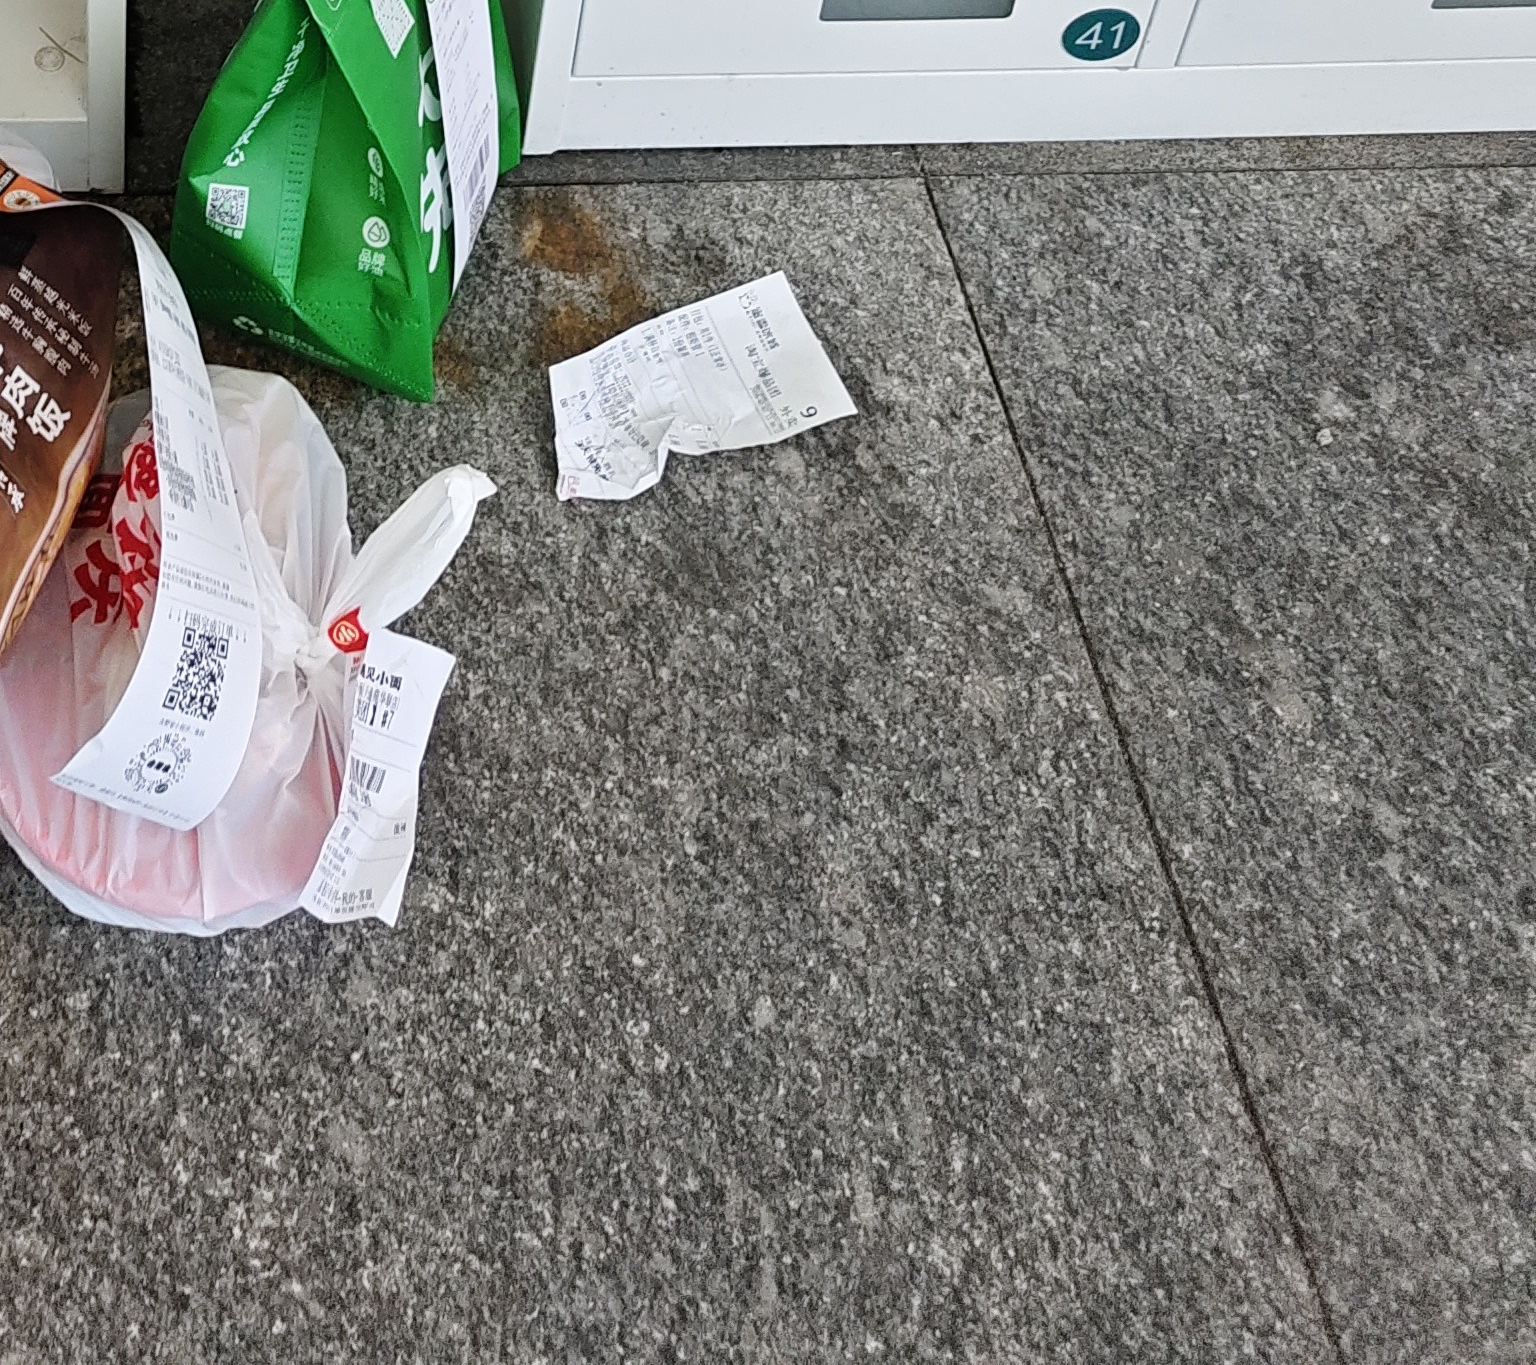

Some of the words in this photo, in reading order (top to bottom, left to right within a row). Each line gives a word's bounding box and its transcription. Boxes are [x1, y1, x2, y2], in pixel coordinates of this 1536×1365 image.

[1075, 22, 1127, 50] 41
[361, 664, 402, 691] 见小面
